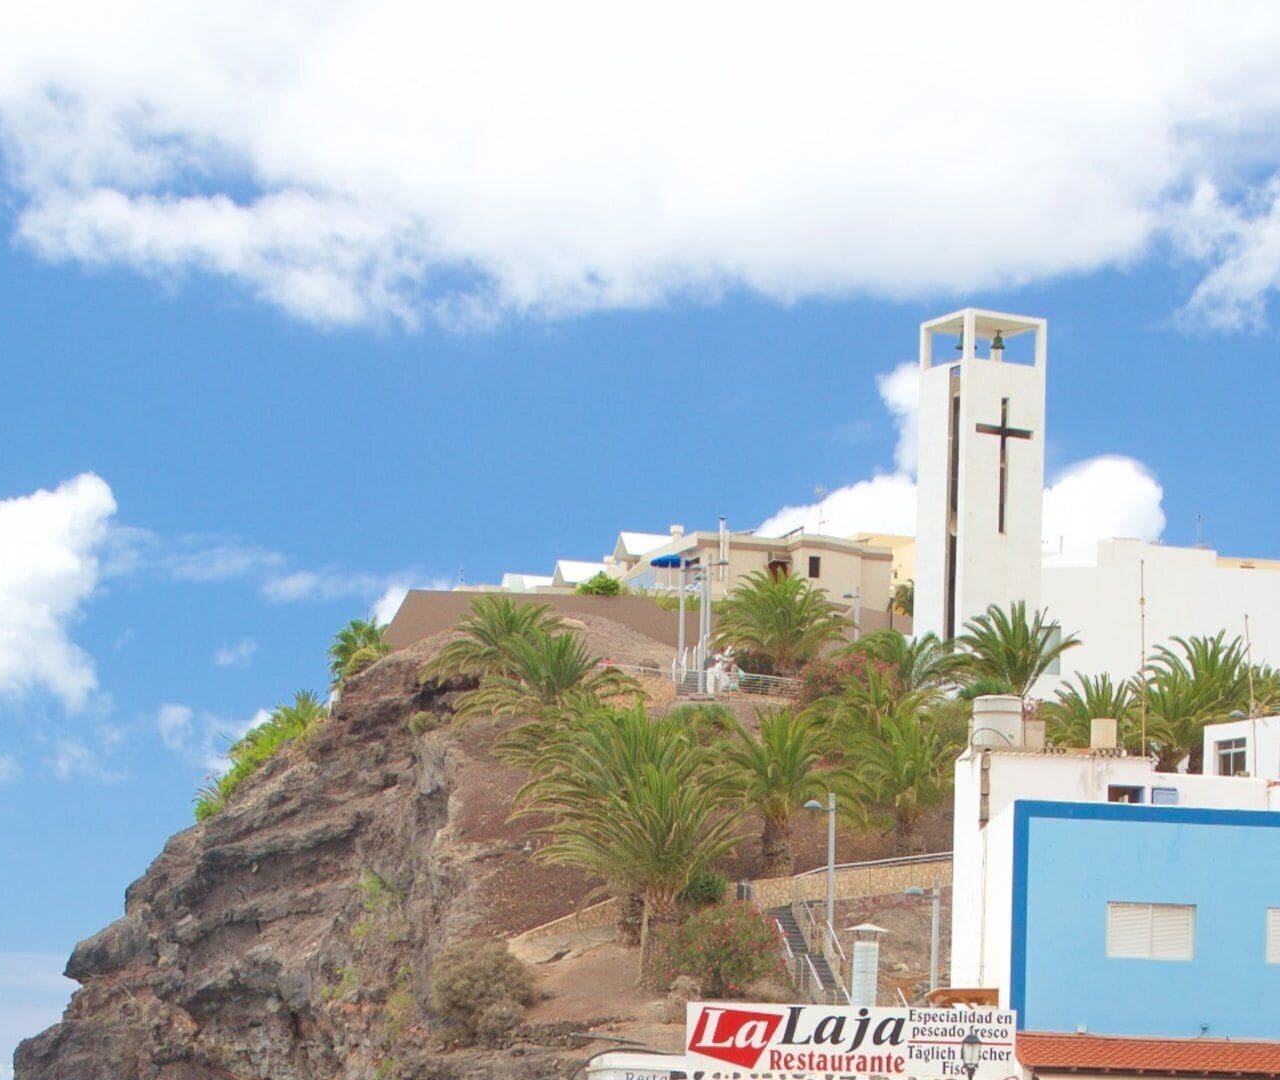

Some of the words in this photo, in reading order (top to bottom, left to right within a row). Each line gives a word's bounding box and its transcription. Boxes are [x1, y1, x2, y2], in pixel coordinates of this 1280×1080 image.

[909, 1009, 993, 1024] Especialidad
[996, 1014, 1013, 1025] en
[695, 1009, 769, 1049] La
[777, 1006, 906, 1053] Laja
[912, 1025, 965, 1039] pescado
[770, 1049, 906, 1074] Restaurante
[907, 1045, 956, 1063] Täglich
